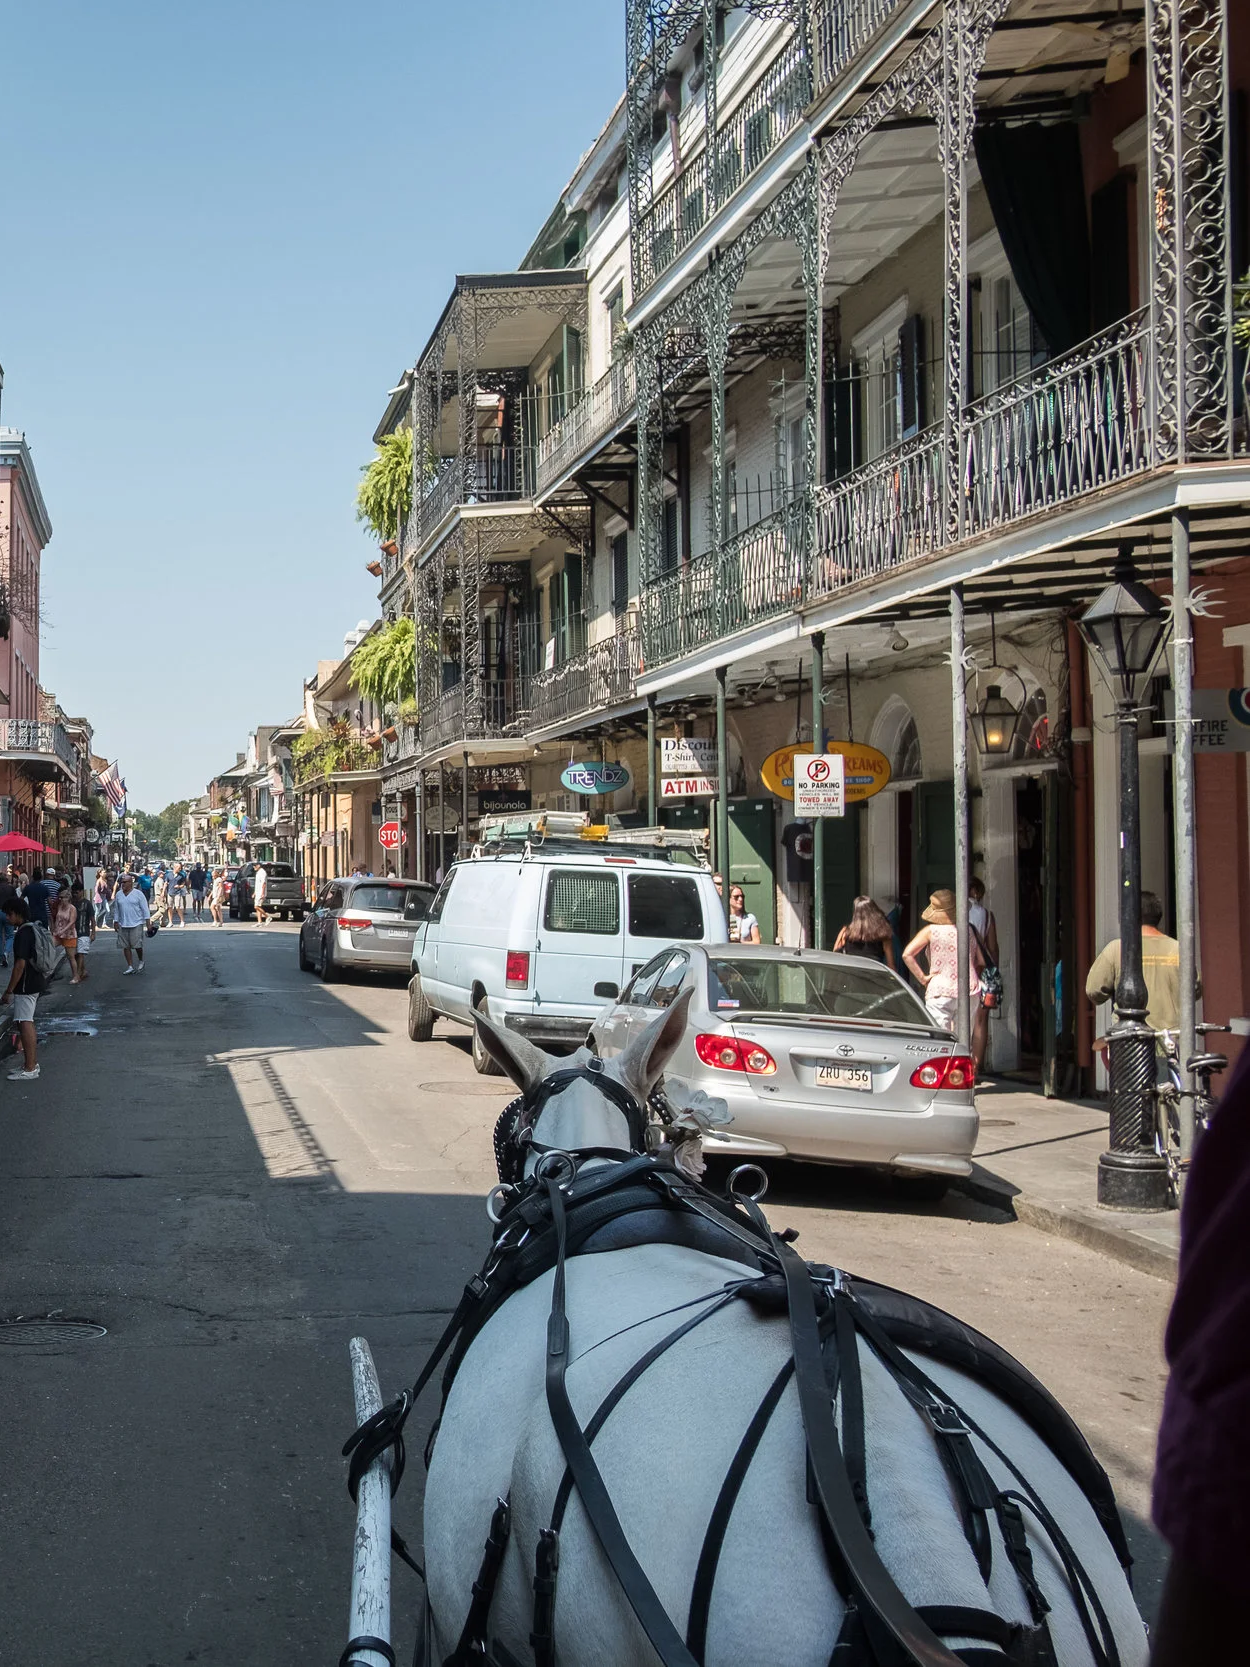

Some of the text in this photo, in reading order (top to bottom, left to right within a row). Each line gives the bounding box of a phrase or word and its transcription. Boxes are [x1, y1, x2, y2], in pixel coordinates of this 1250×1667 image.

[665, 753, 696, 761] T-Shirt
[844, 756, 884, 775] REAMS
[567, 770, 624, 788] TRENDZ
[664, 780, 698, 794] ATM
[483, 801, 527, 811] bijounola
[819, 1065, 869, 1082] ZRU 356
